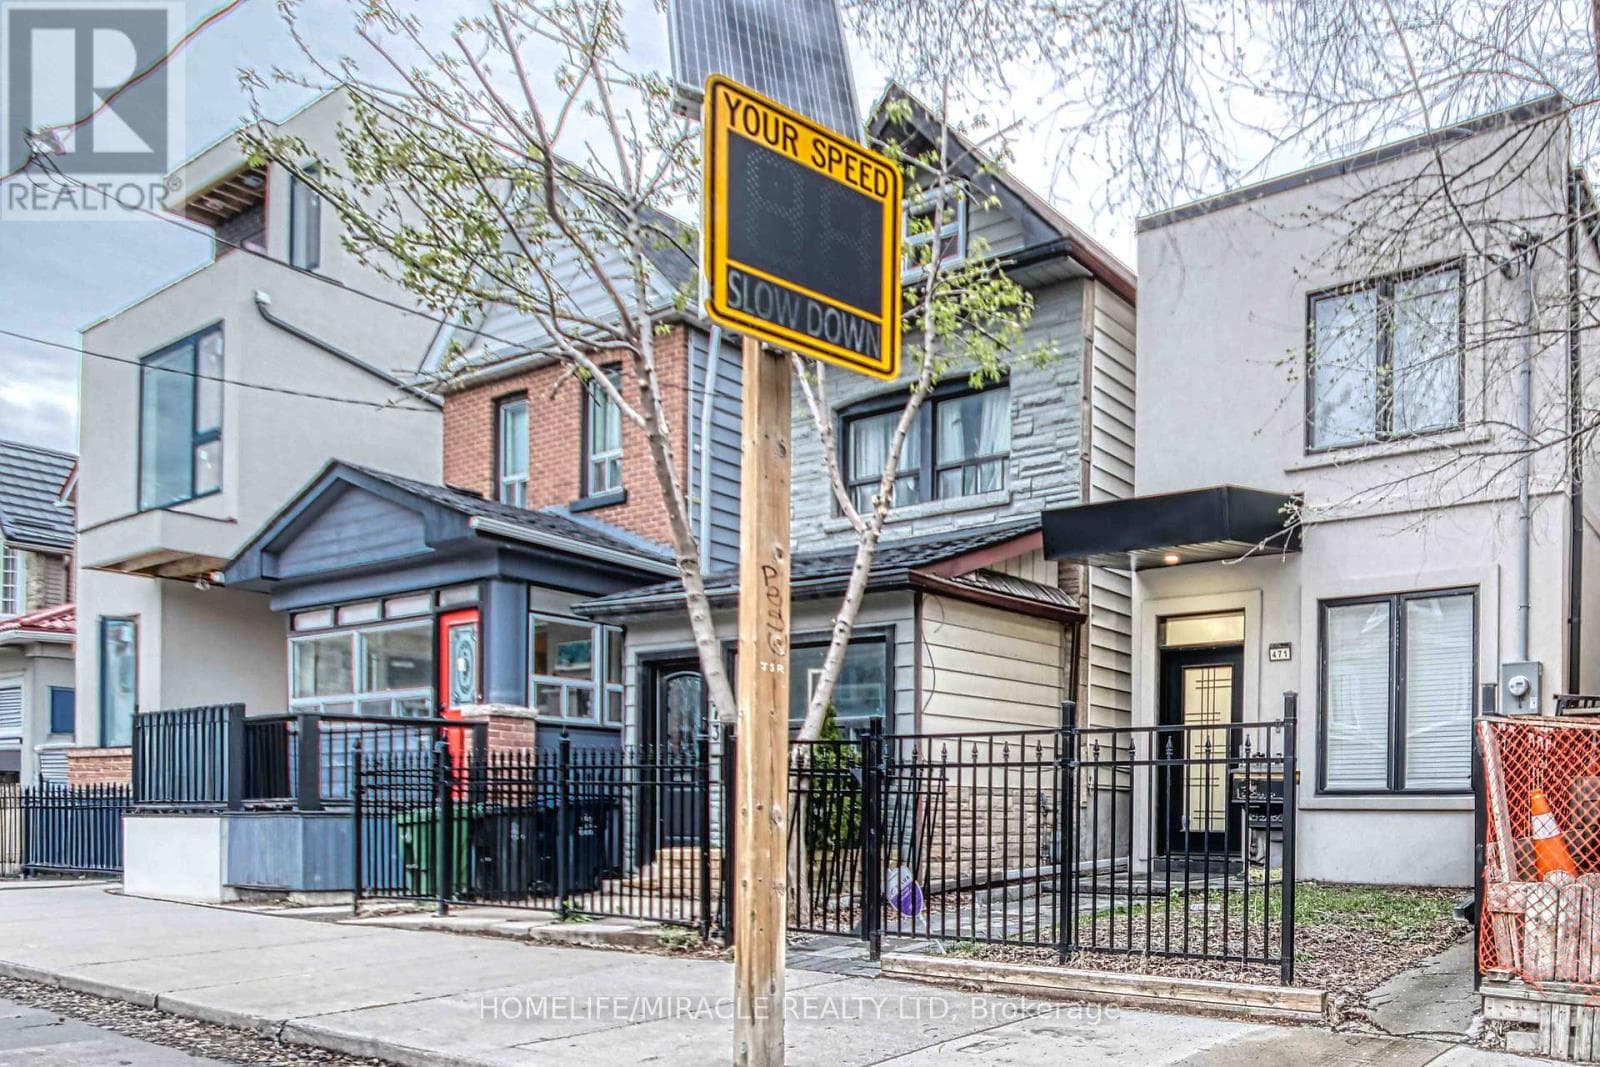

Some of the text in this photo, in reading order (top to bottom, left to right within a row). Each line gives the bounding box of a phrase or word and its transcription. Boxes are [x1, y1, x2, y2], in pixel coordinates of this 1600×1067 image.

[723, 91, 889, 199] YOUR SPEED
[728, 270, 881, 357] SLOW DOWN
[1271, 650, 1288, 659] 471
